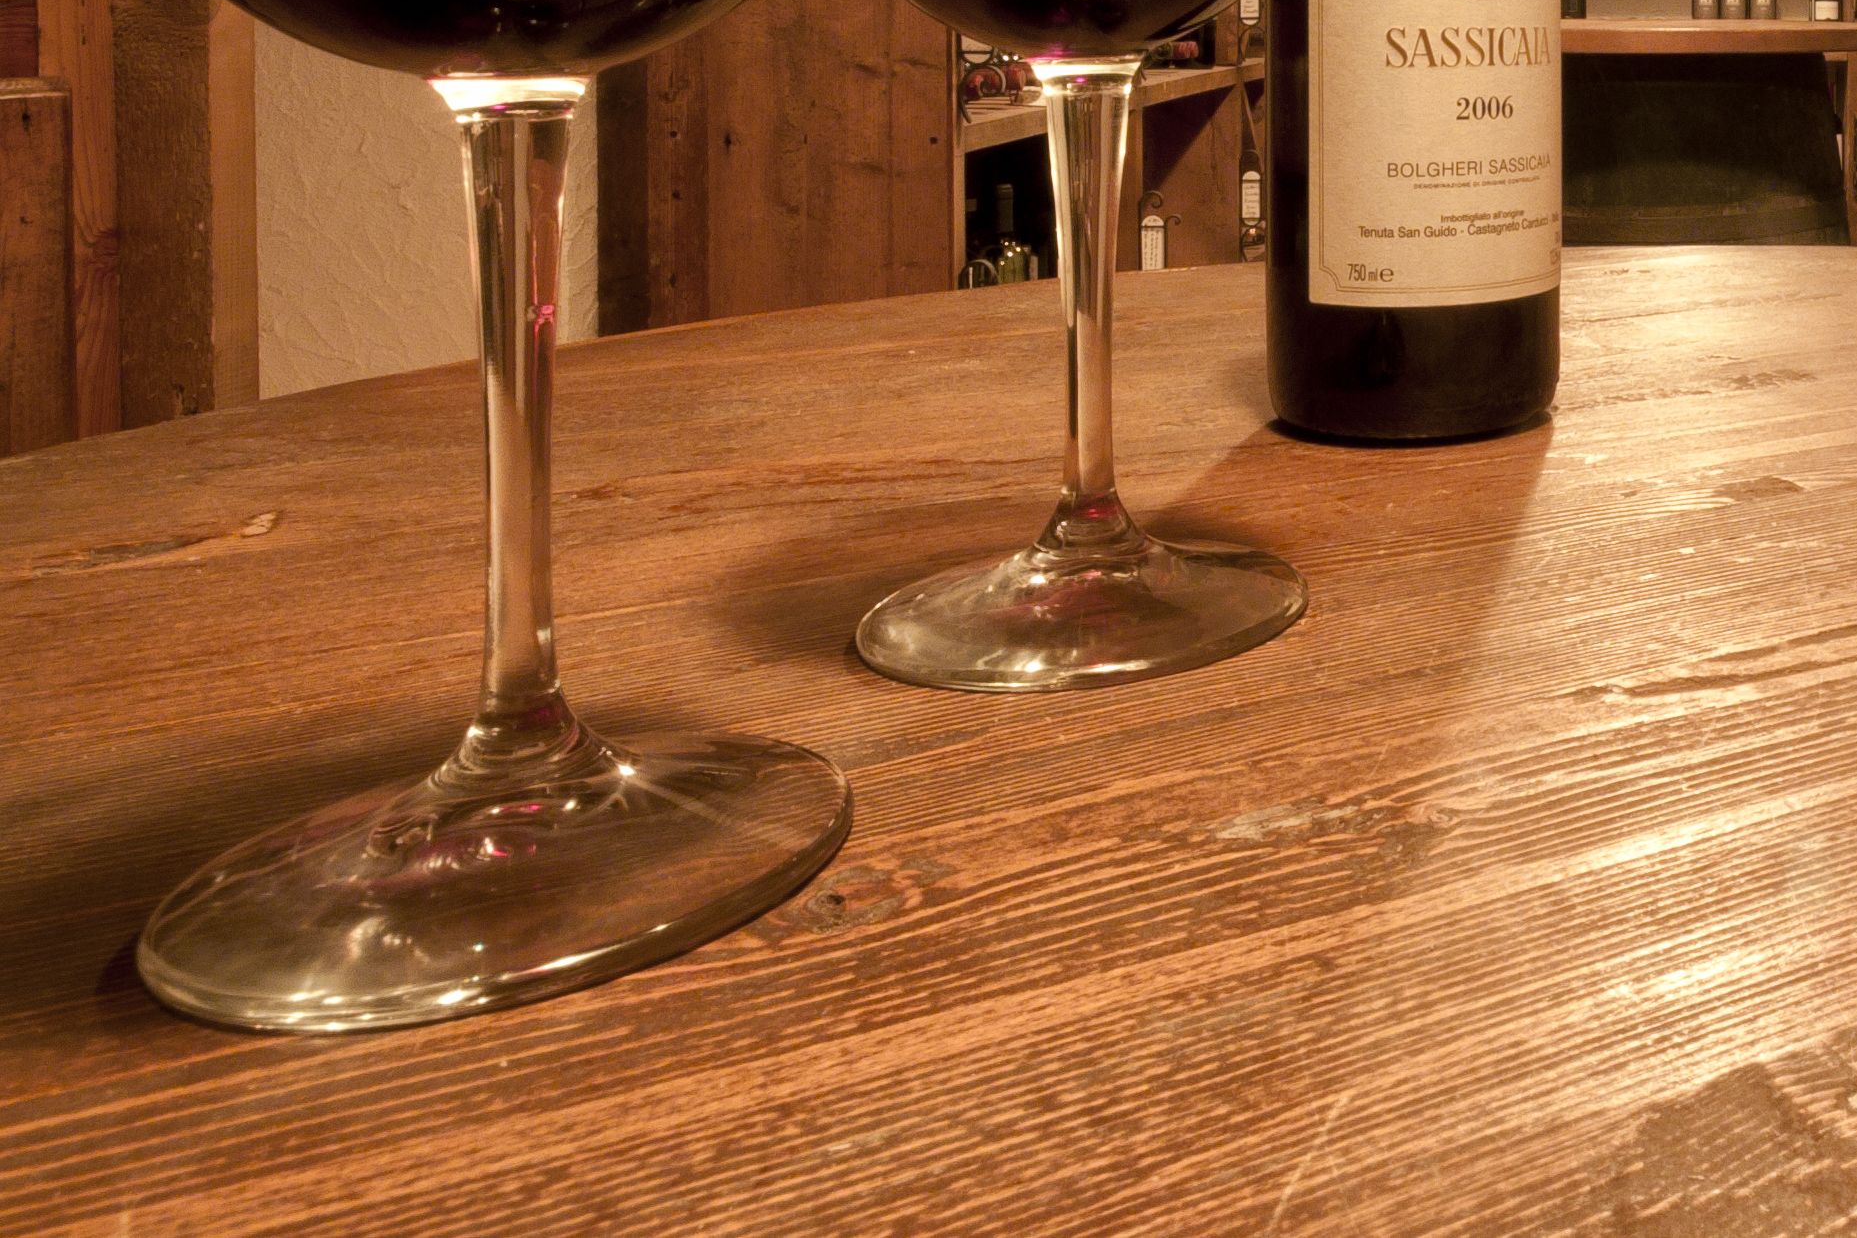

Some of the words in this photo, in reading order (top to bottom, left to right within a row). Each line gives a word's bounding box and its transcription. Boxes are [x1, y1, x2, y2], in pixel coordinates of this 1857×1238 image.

[1386, 26, 1551, 68] SASSICAIA
[1456, 95, 1514, 121] 2006
[1387, 161, 1483, 178] BOLGHERI
[1488, 153, 1551, 175] SASSICAIA
[1440, 212, 1491, 224] Imbottigliato
[1492, 209, 1525, 221] all'origine
[1358, 225, 1395, 238] Tenuta
[1397, 225, 1421, 238] San
[1423, 225, 1458, 237] Guido
[1467, 221, 1520, 236] Castagneto
[1347, 263, 1367, 281] 750
[1368, 267, 1378, 281] ml
